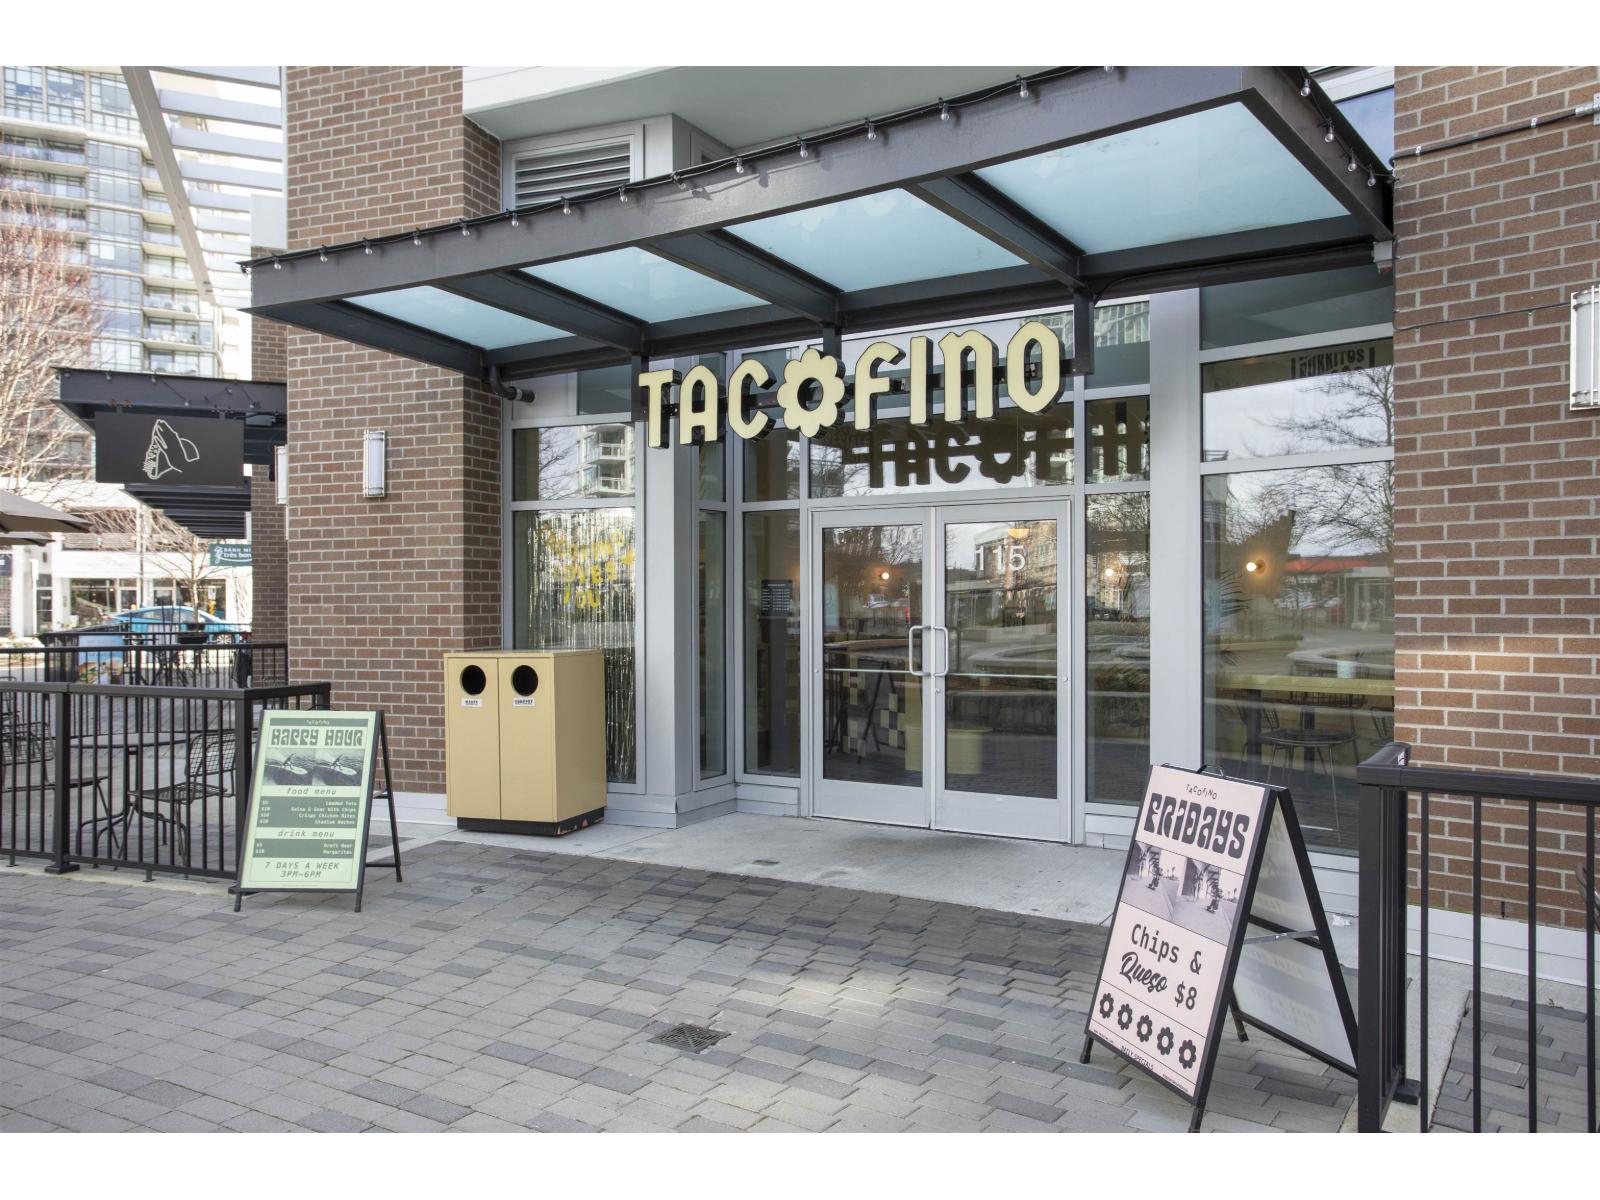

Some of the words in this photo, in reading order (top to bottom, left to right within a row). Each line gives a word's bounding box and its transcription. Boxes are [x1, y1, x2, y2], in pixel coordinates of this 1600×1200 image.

[638, 321, 1065, 448] TACOFINO
[976, 545, 1025, 573] 115
[271, 728, 319, 746] HAPPY
[324, 729, 363, 746] HOUR
[1186, 784, 1217, 800] TACOFINO
[1144, 793, 1250, 859] FRIDAYS
[316, 862, 339, 870] WEEK
[1131, 923, 1180, 964] Chips
[1190, 950, 1202, 975] &
[1119, 951, 1168, 993] Queso
[1174, 980, 1198, 1010] $8
